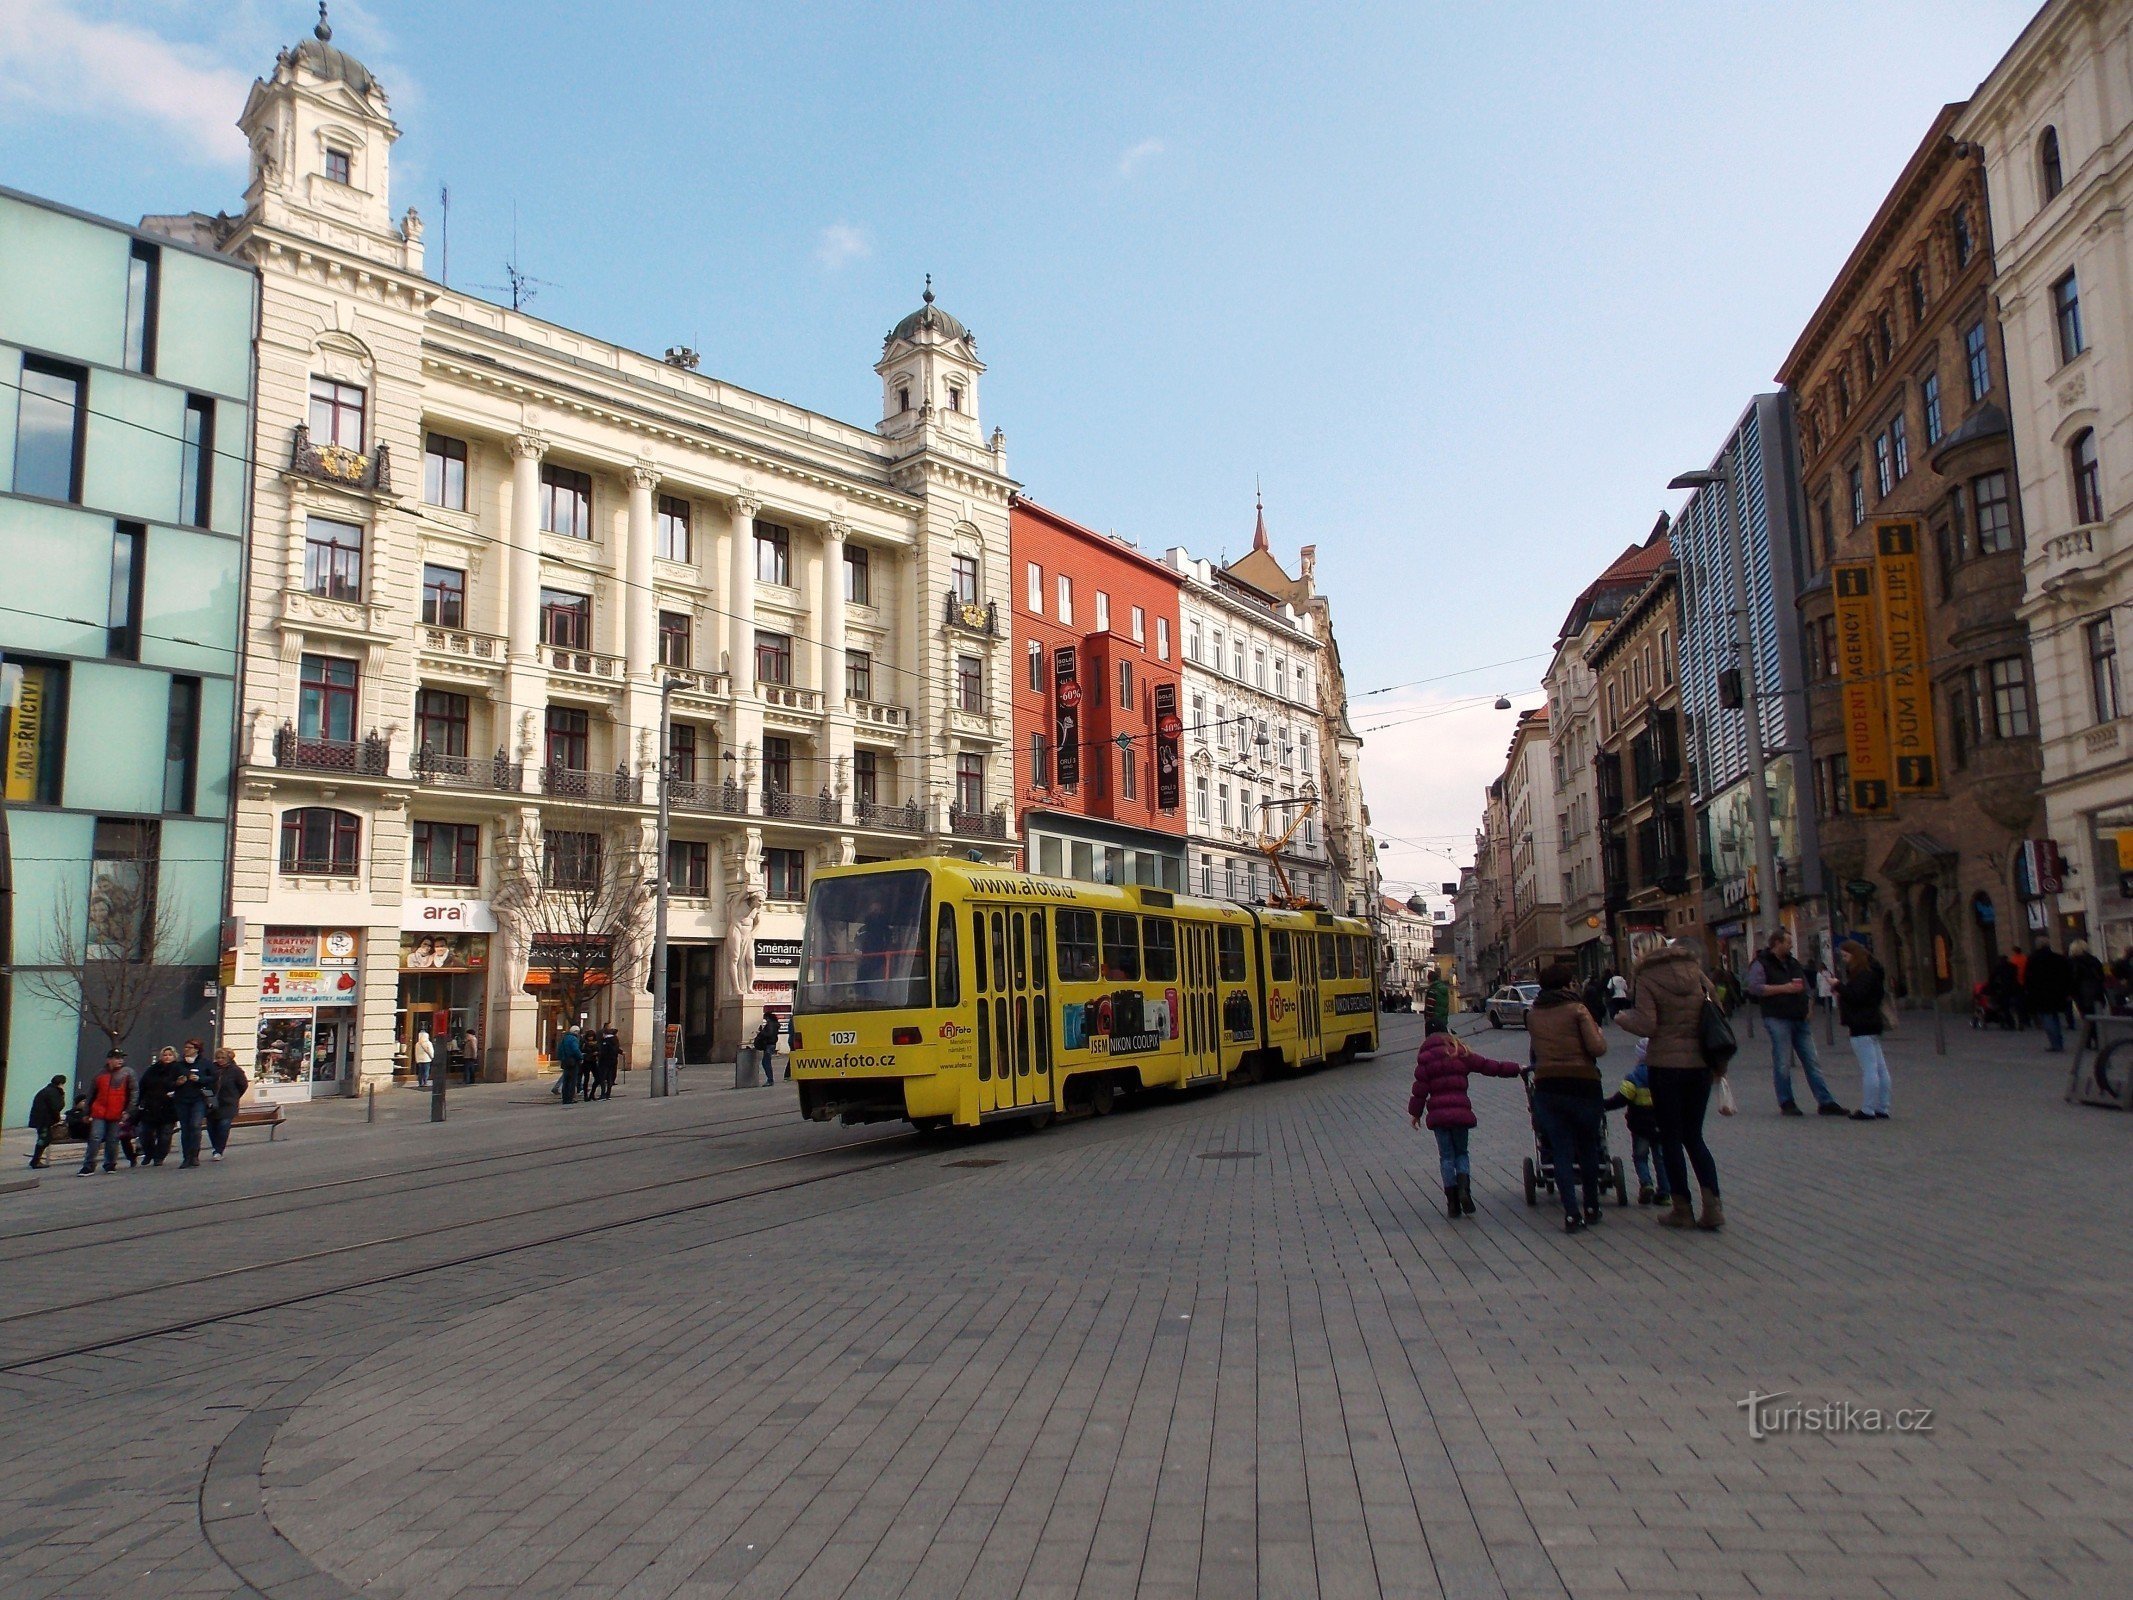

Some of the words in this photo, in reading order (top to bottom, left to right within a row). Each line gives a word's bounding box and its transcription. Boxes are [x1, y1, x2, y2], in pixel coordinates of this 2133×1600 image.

[1890, 611, 1909, 621] Z
[1844, 612, 1863, 676] AGENCY
[1060, 690, 1081, 701] -60%
[1850, 690, 1871, 764] STUDENT
[968, 877, 1077, 899] www.afoto.cz
[423, 906, 460, 919] ara
[769, 957, 792, 965] Exchange
[753, 983, 789, 992] XCHANGE
[830, 1032, 856, 1044] 1037
[1090, 1039, 1108, 1055] JSEM
[1110, 1036, 1131, 1052] NIKON
[1132, 1033, 1159, 1049] COOLPIX
[796, 1053, 896, 1069] www.afoto.cz
